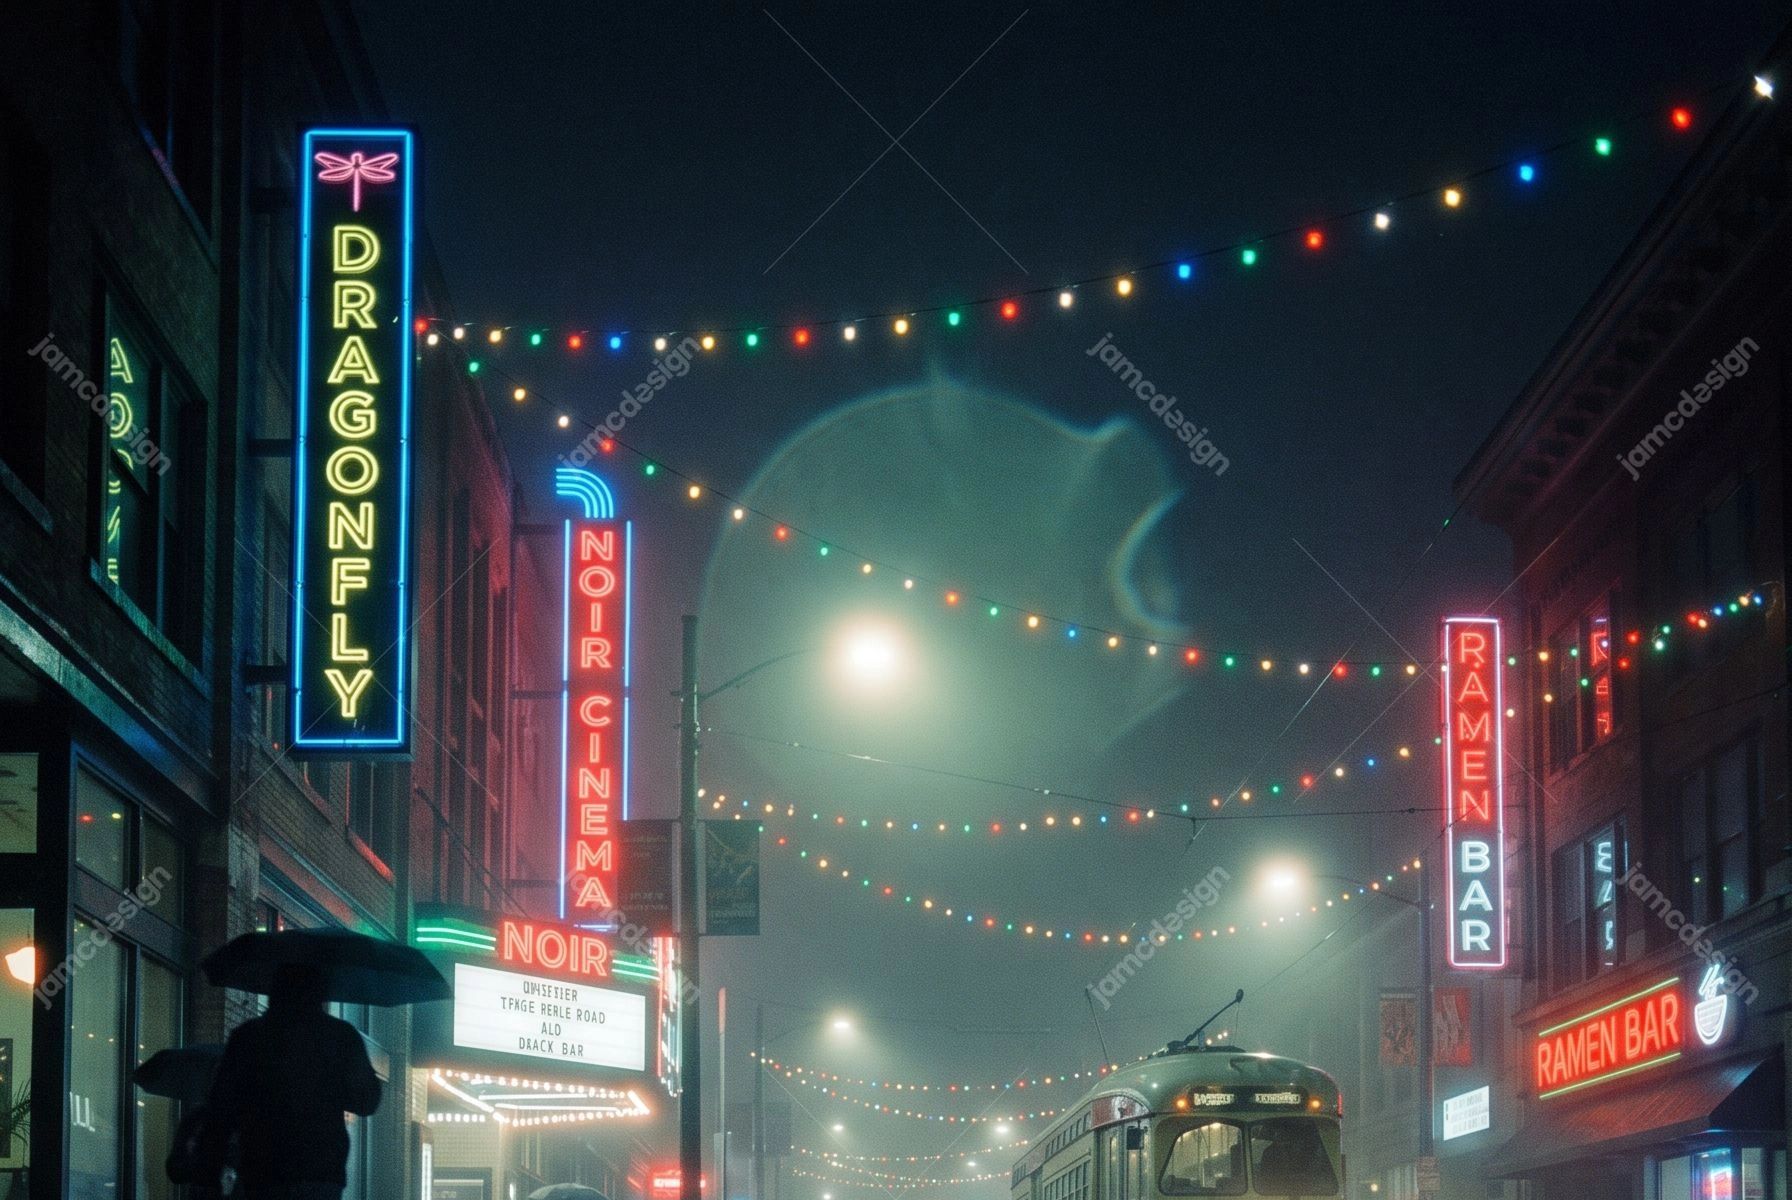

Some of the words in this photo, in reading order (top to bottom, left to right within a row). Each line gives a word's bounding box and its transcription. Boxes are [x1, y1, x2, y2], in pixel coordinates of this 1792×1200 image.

[325, 225, 380, 717] DRAGONFLY
[578, 530, 615, 669] NOIR
[1458, 632, 1490, 821] RAMEN
[575, 696, 613, 908] CINEMA
[504, 921, 607, 977] NOIR
[1458, 840, 1493, 952] BAR
[562, 1042, 584, 1057] BAR
[576, 1008, 605, 1024] ROAD
[1538, 1015, 1616, 1087] RAMEN
[1625, 993, 1679, 1060] BAR
